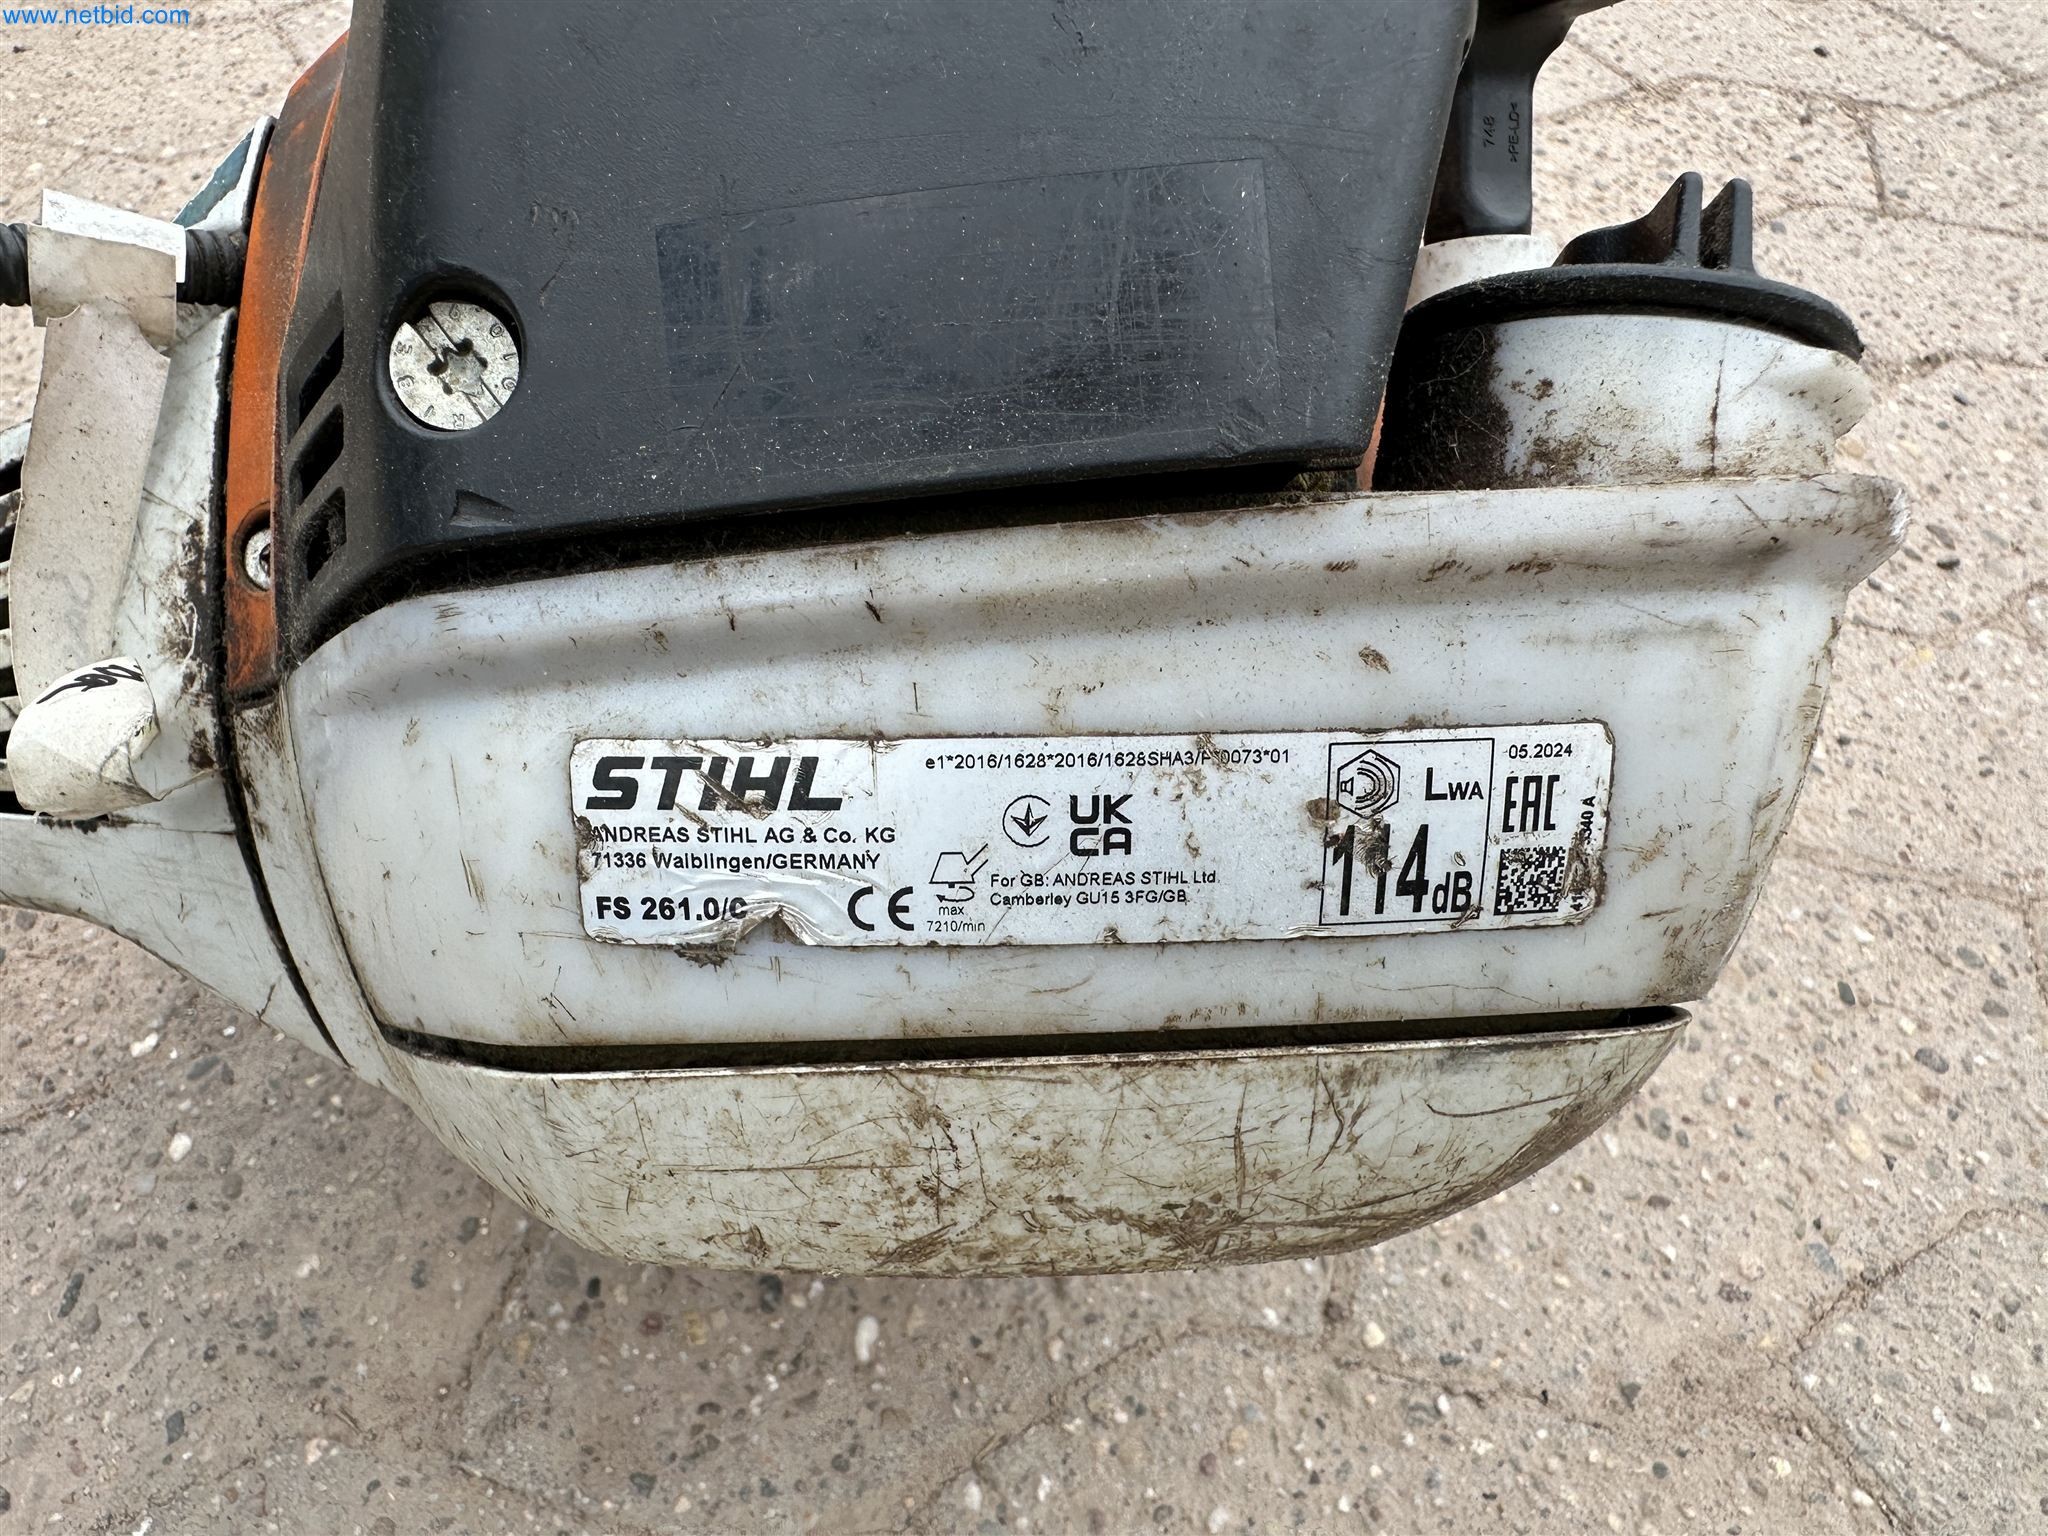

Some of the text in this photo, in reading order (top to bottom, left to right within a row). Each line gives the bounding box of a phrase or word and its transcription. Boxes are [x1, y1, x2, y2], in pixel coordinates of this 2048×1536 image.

[1508, 743, 1572, 759] 05.2024
[585, 756, 843, 811] STIHL
[1069, 794, 1133, 824] UK
[592, 827, 896, 843] ANDREAS STIHL AG & Co. KG
[1069, 828, 1132, 856] CA
[592, 852, 880, 873] 71336 Waiblingen/GERMANY
[990, 873, 1018, 887] For
[1021, 873, 1049, 887] GB:
[1053, 872, 1135, 887] ANDREAS
[1140, 871, 1188, 885] STIHL
[596, 896, 631, 920] FS
[847, 885, 914, 932] CE
[990, 890, 1187, 909] Camberley GU15 3FG/GB
[938, 905, 964, 917] max
[926, 919, 986, 933] 7210/min
